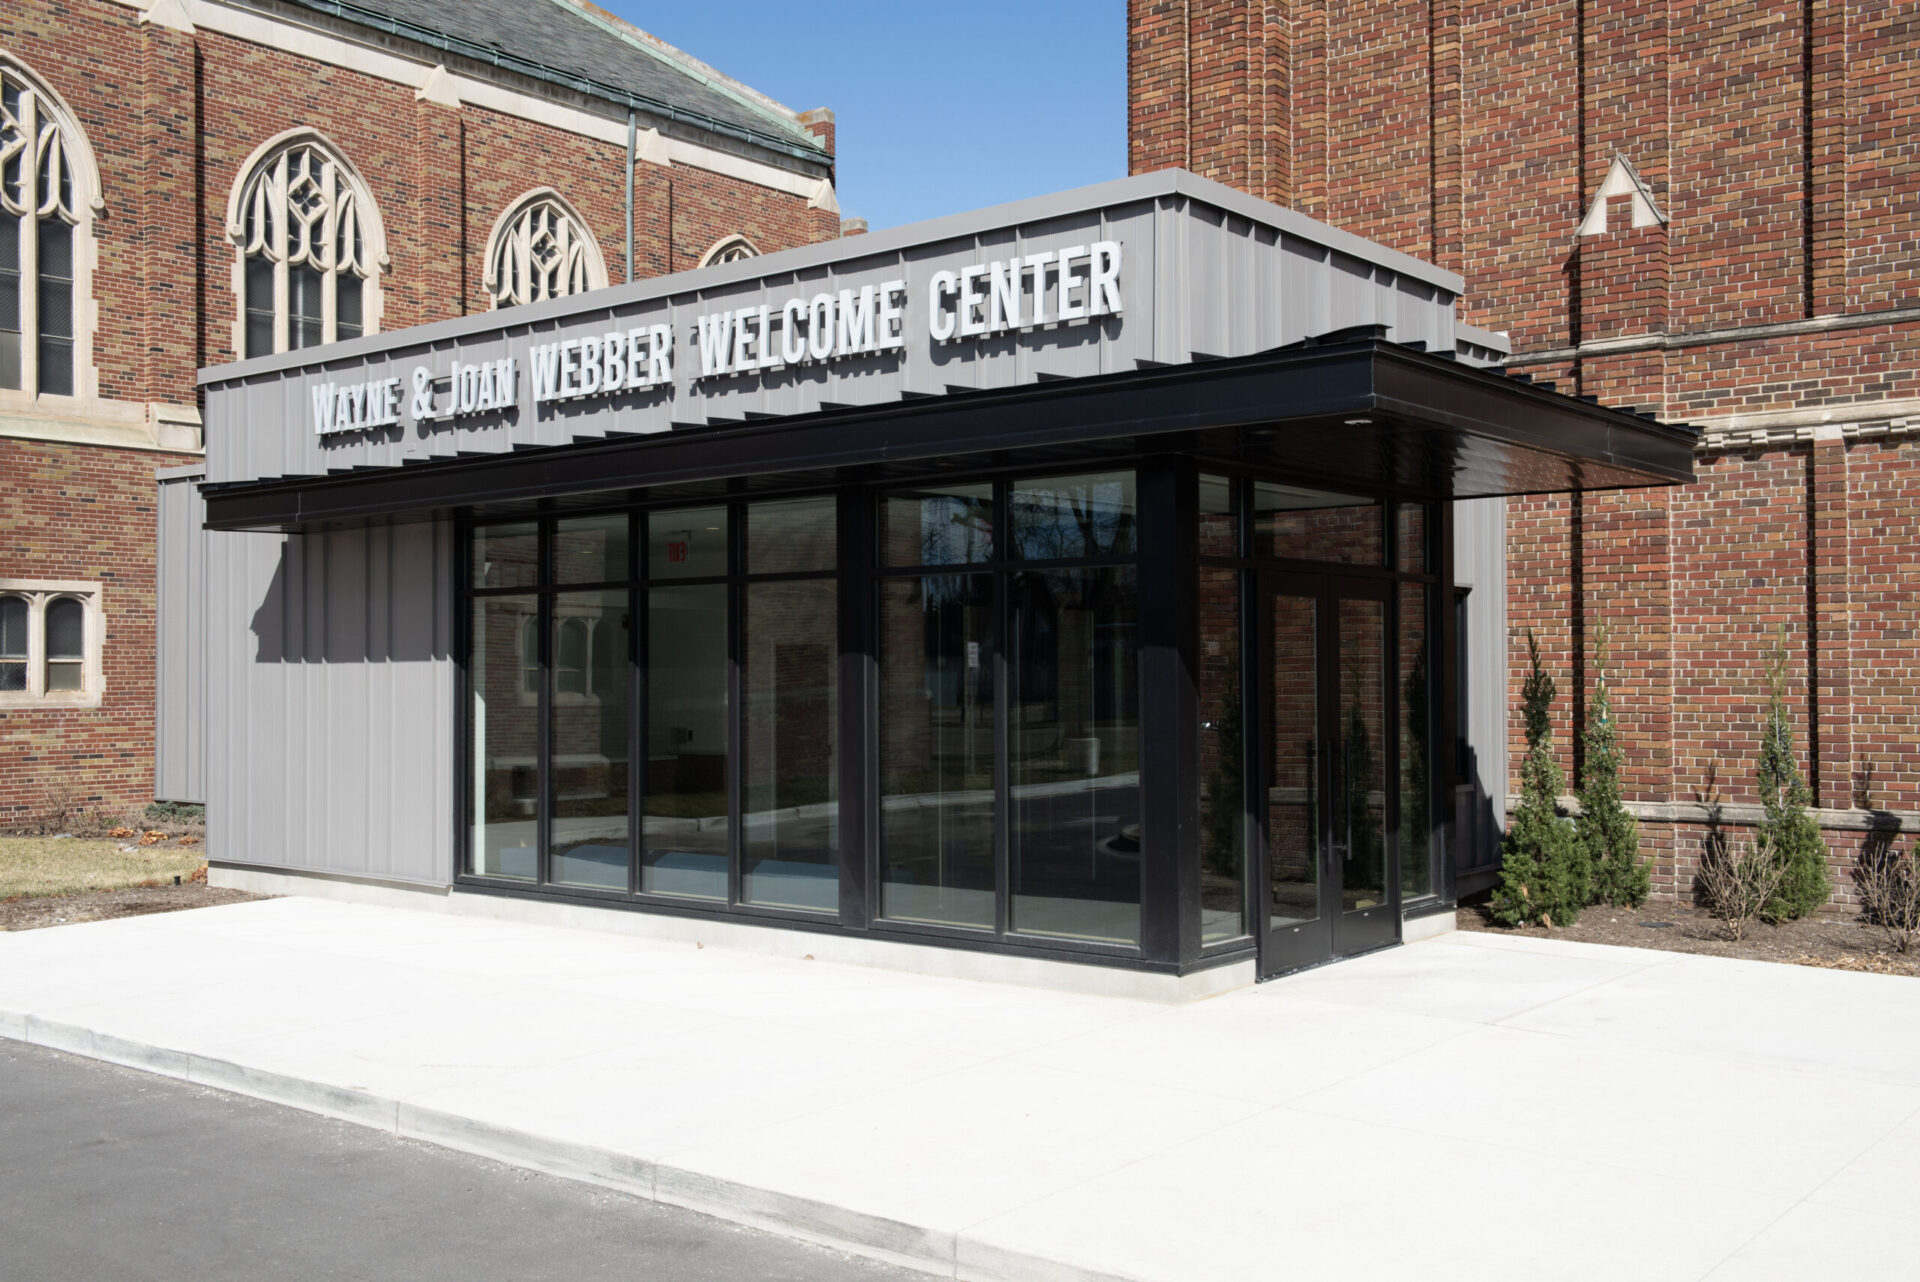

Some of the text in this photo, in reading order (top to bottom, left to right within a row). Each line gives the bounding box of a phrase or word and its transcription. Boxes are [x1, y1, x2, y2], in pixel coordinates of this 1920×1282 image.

[312, 240, 1124, 434] WAYNE & JOAN WEBBER WELCOME CENTER
